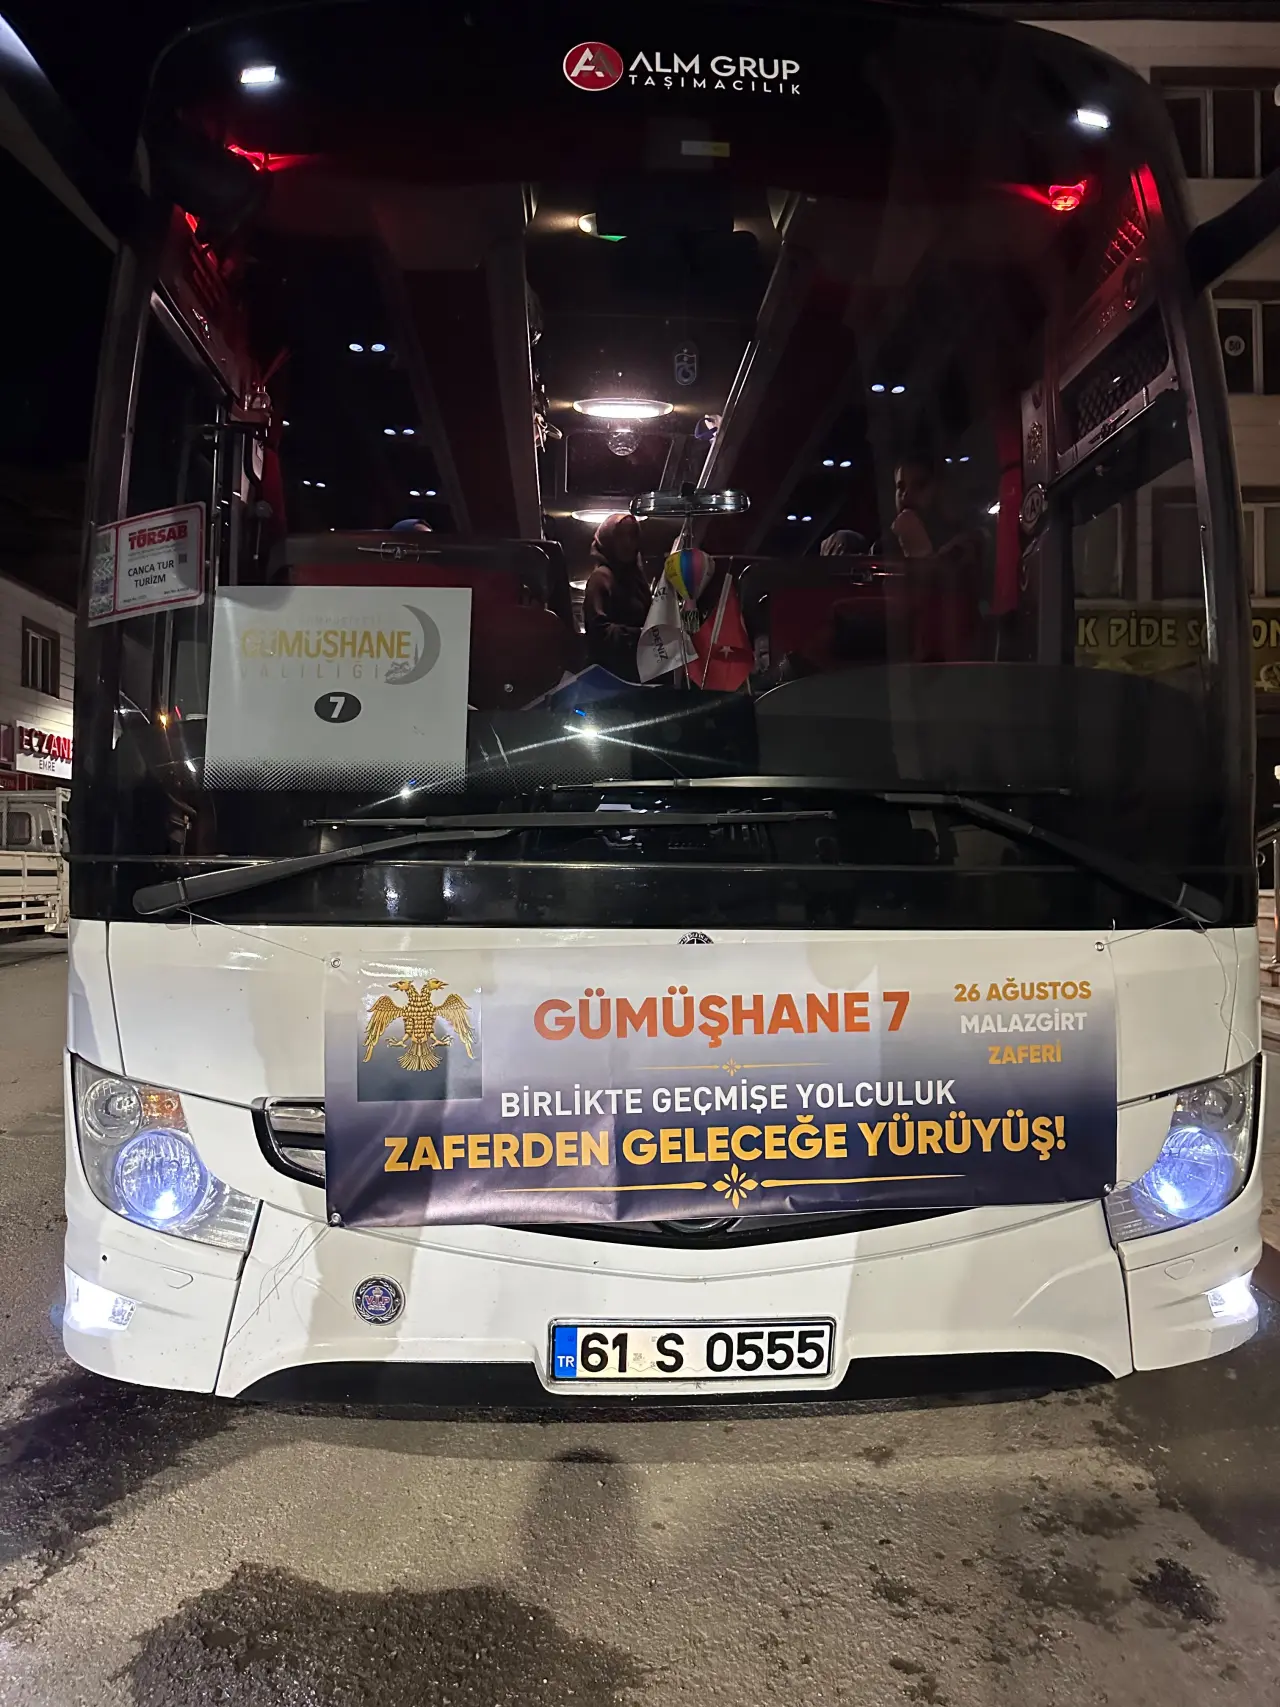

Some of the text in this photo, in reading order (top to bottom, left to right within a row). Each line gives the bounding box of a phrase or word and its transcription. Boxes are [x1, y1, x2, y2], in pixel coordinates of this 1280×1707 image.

[628, 51, 801, 80] ALM GRUP
[628, 74, 801, 95] TAŞIMACILIK
[127, 559, 174, 577] CANCA TUR
[134, 574, 166, 588] TURİZM
[1109, 610, 1177, 647] PİDE
[240, 629, 412, 663] GÜMÜŞHANE
[329, 696, 346, 719] 7
[19, 726, 73, 759] ECZAN
[39, 759, 55, 772] EMRE
[953, 976, 1092, 1003] 26 AĞUSTOS
[533, 985, 911, 1049] GÜMÜŞHANE 7
[959, 1007, 1088, 1034] MALAZGİRT
[987, 1039, 1062, 1065] ZAFERİ
[501, 1078, 957, 1118] BİRLİKTE GEÇMİŞE YOLCULUK
[384, 1108, 1066, 1172] ZAFERDEN GELECEĞE YÜRÜYÜŞ!
[557, 1355, 575, 1368] TR
[580, 1330, 825, 1373] 61 S 0555
